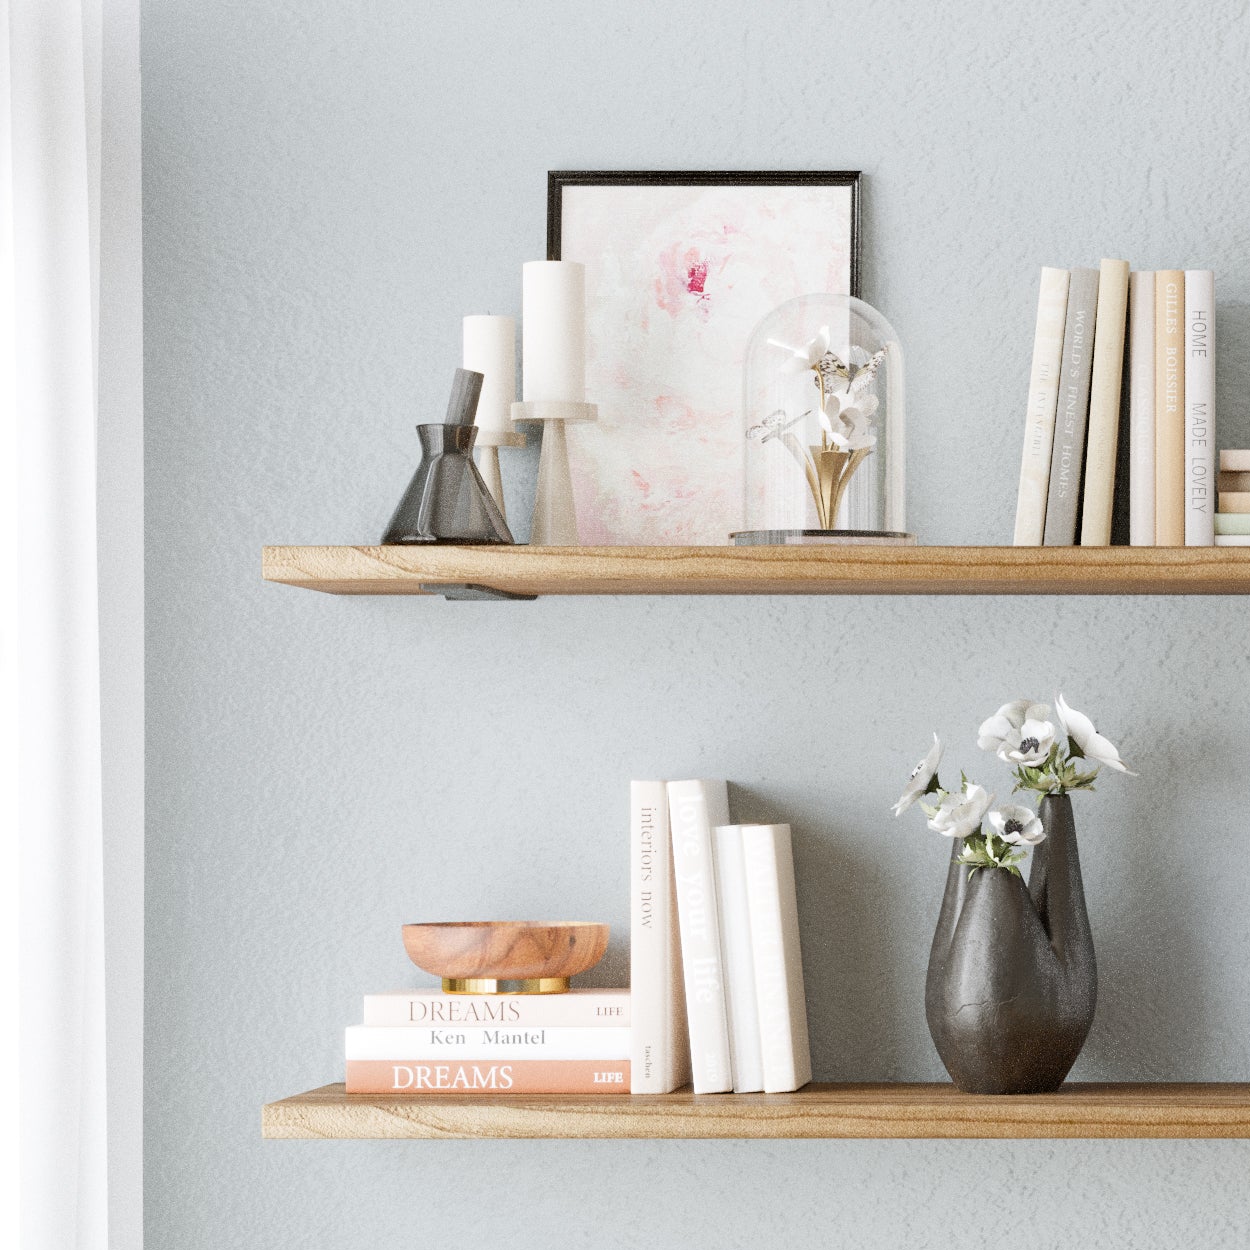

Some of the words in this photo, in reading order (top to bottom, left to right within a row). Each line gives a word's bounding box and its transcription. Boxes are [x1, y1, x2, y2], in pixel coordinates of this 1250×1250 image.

[1166, 282, 1177, 335] GILLES
[1068, 309, 1086, 379] WORLD'S
[1191, 310, 1207, 358] HOME
[1166, 347, 1177, 412] BOISSIER
[1065, 386, 1079, 436] FINEST
[1191, 403, 1207, 448] MADE
[1058, 444, 1074, 498] HOMES
[1191, 457, 1207, 514] LOVELY
[641, 807, 657, 882] interiors
[640, 890, 652, 929] now
[683, 869, 708, 941] your
[693, 957, 721, 1004] life
[409, 1000, 521, 1022] DREAMS
[596, 1007, 624, 1017] LIFE
[430, 1030, 466, 1045] Ken
[482, 1029, 546, 1045] Mantel
[392, 1065, 513, 1089] DREAMS
[593, 1072, 623, 1083] LIFE
